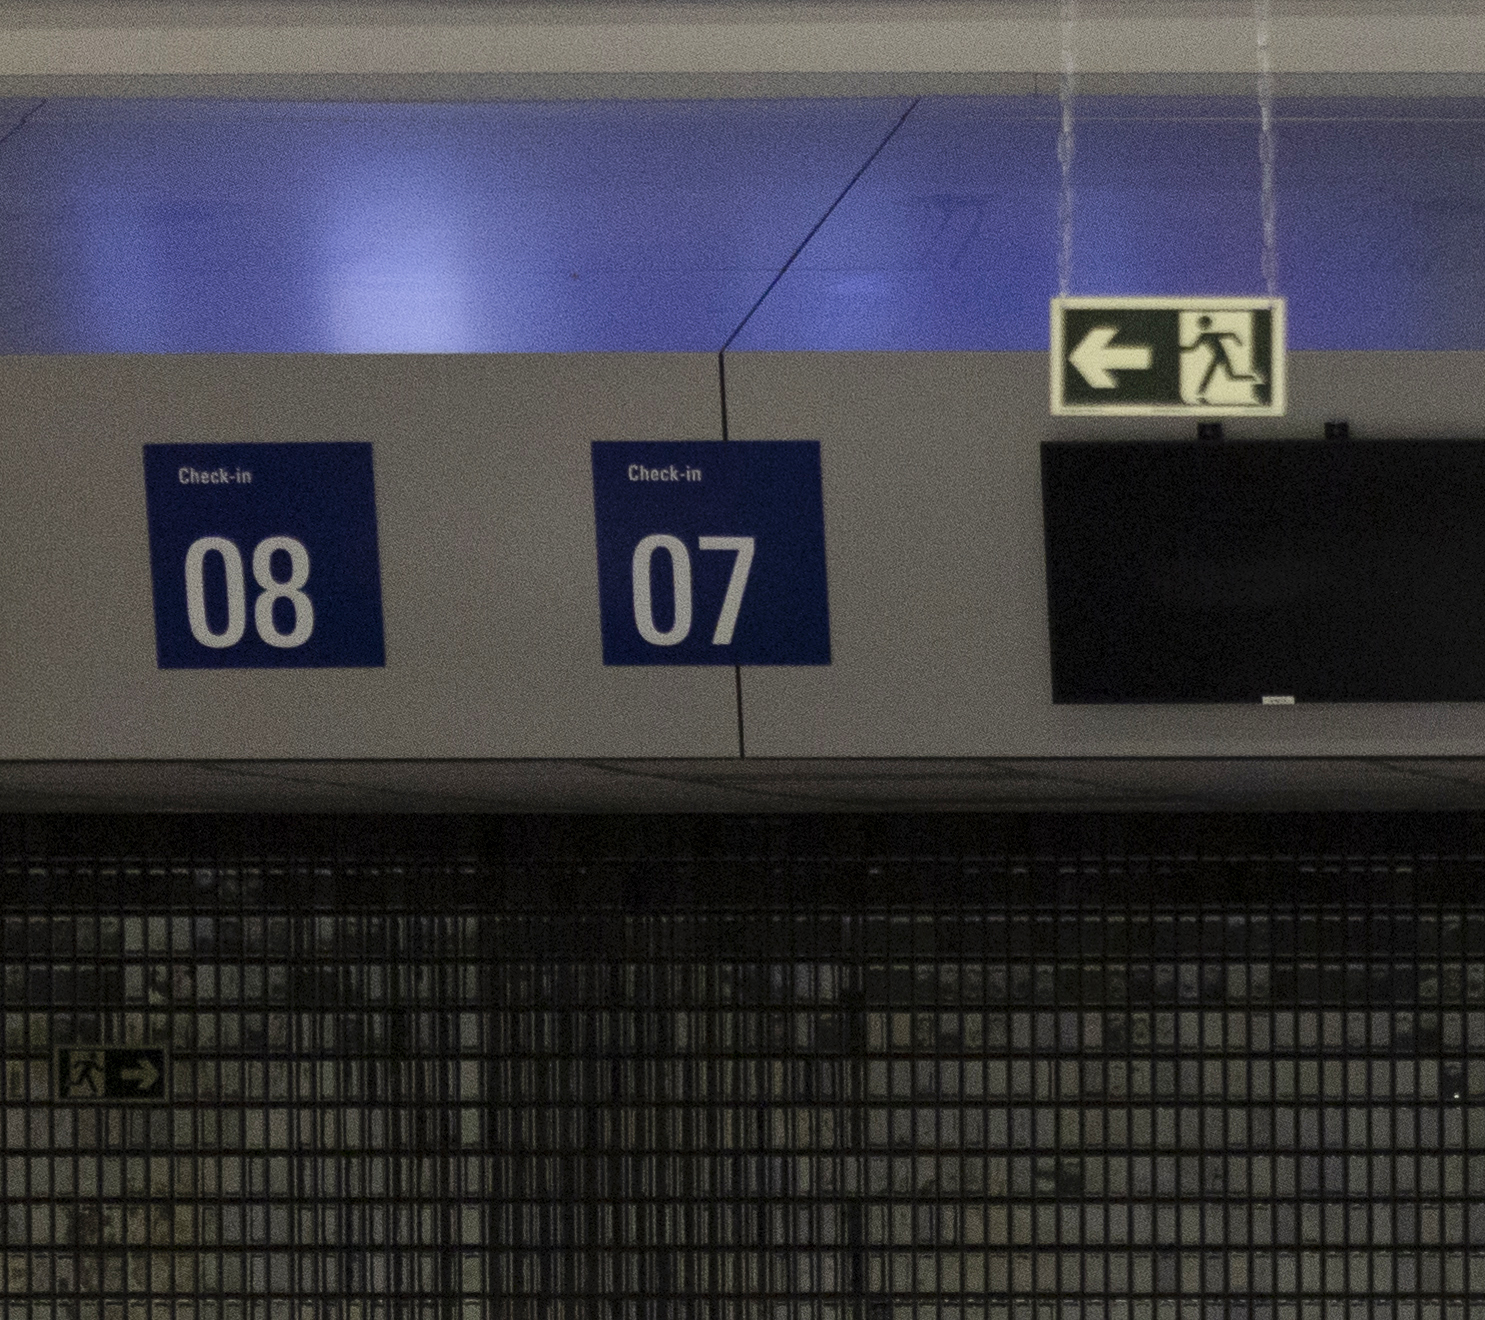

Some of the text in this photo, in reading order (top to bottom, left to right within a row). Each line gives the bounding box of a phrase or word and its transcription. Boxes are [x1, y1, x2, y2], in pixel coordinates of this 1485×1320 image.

[178, 466, 252, 484] Check-in
[628, 464, 702, 481] Check-in
[185, 536, 314, 648] 08
[632, 534, 755, 646] 07
